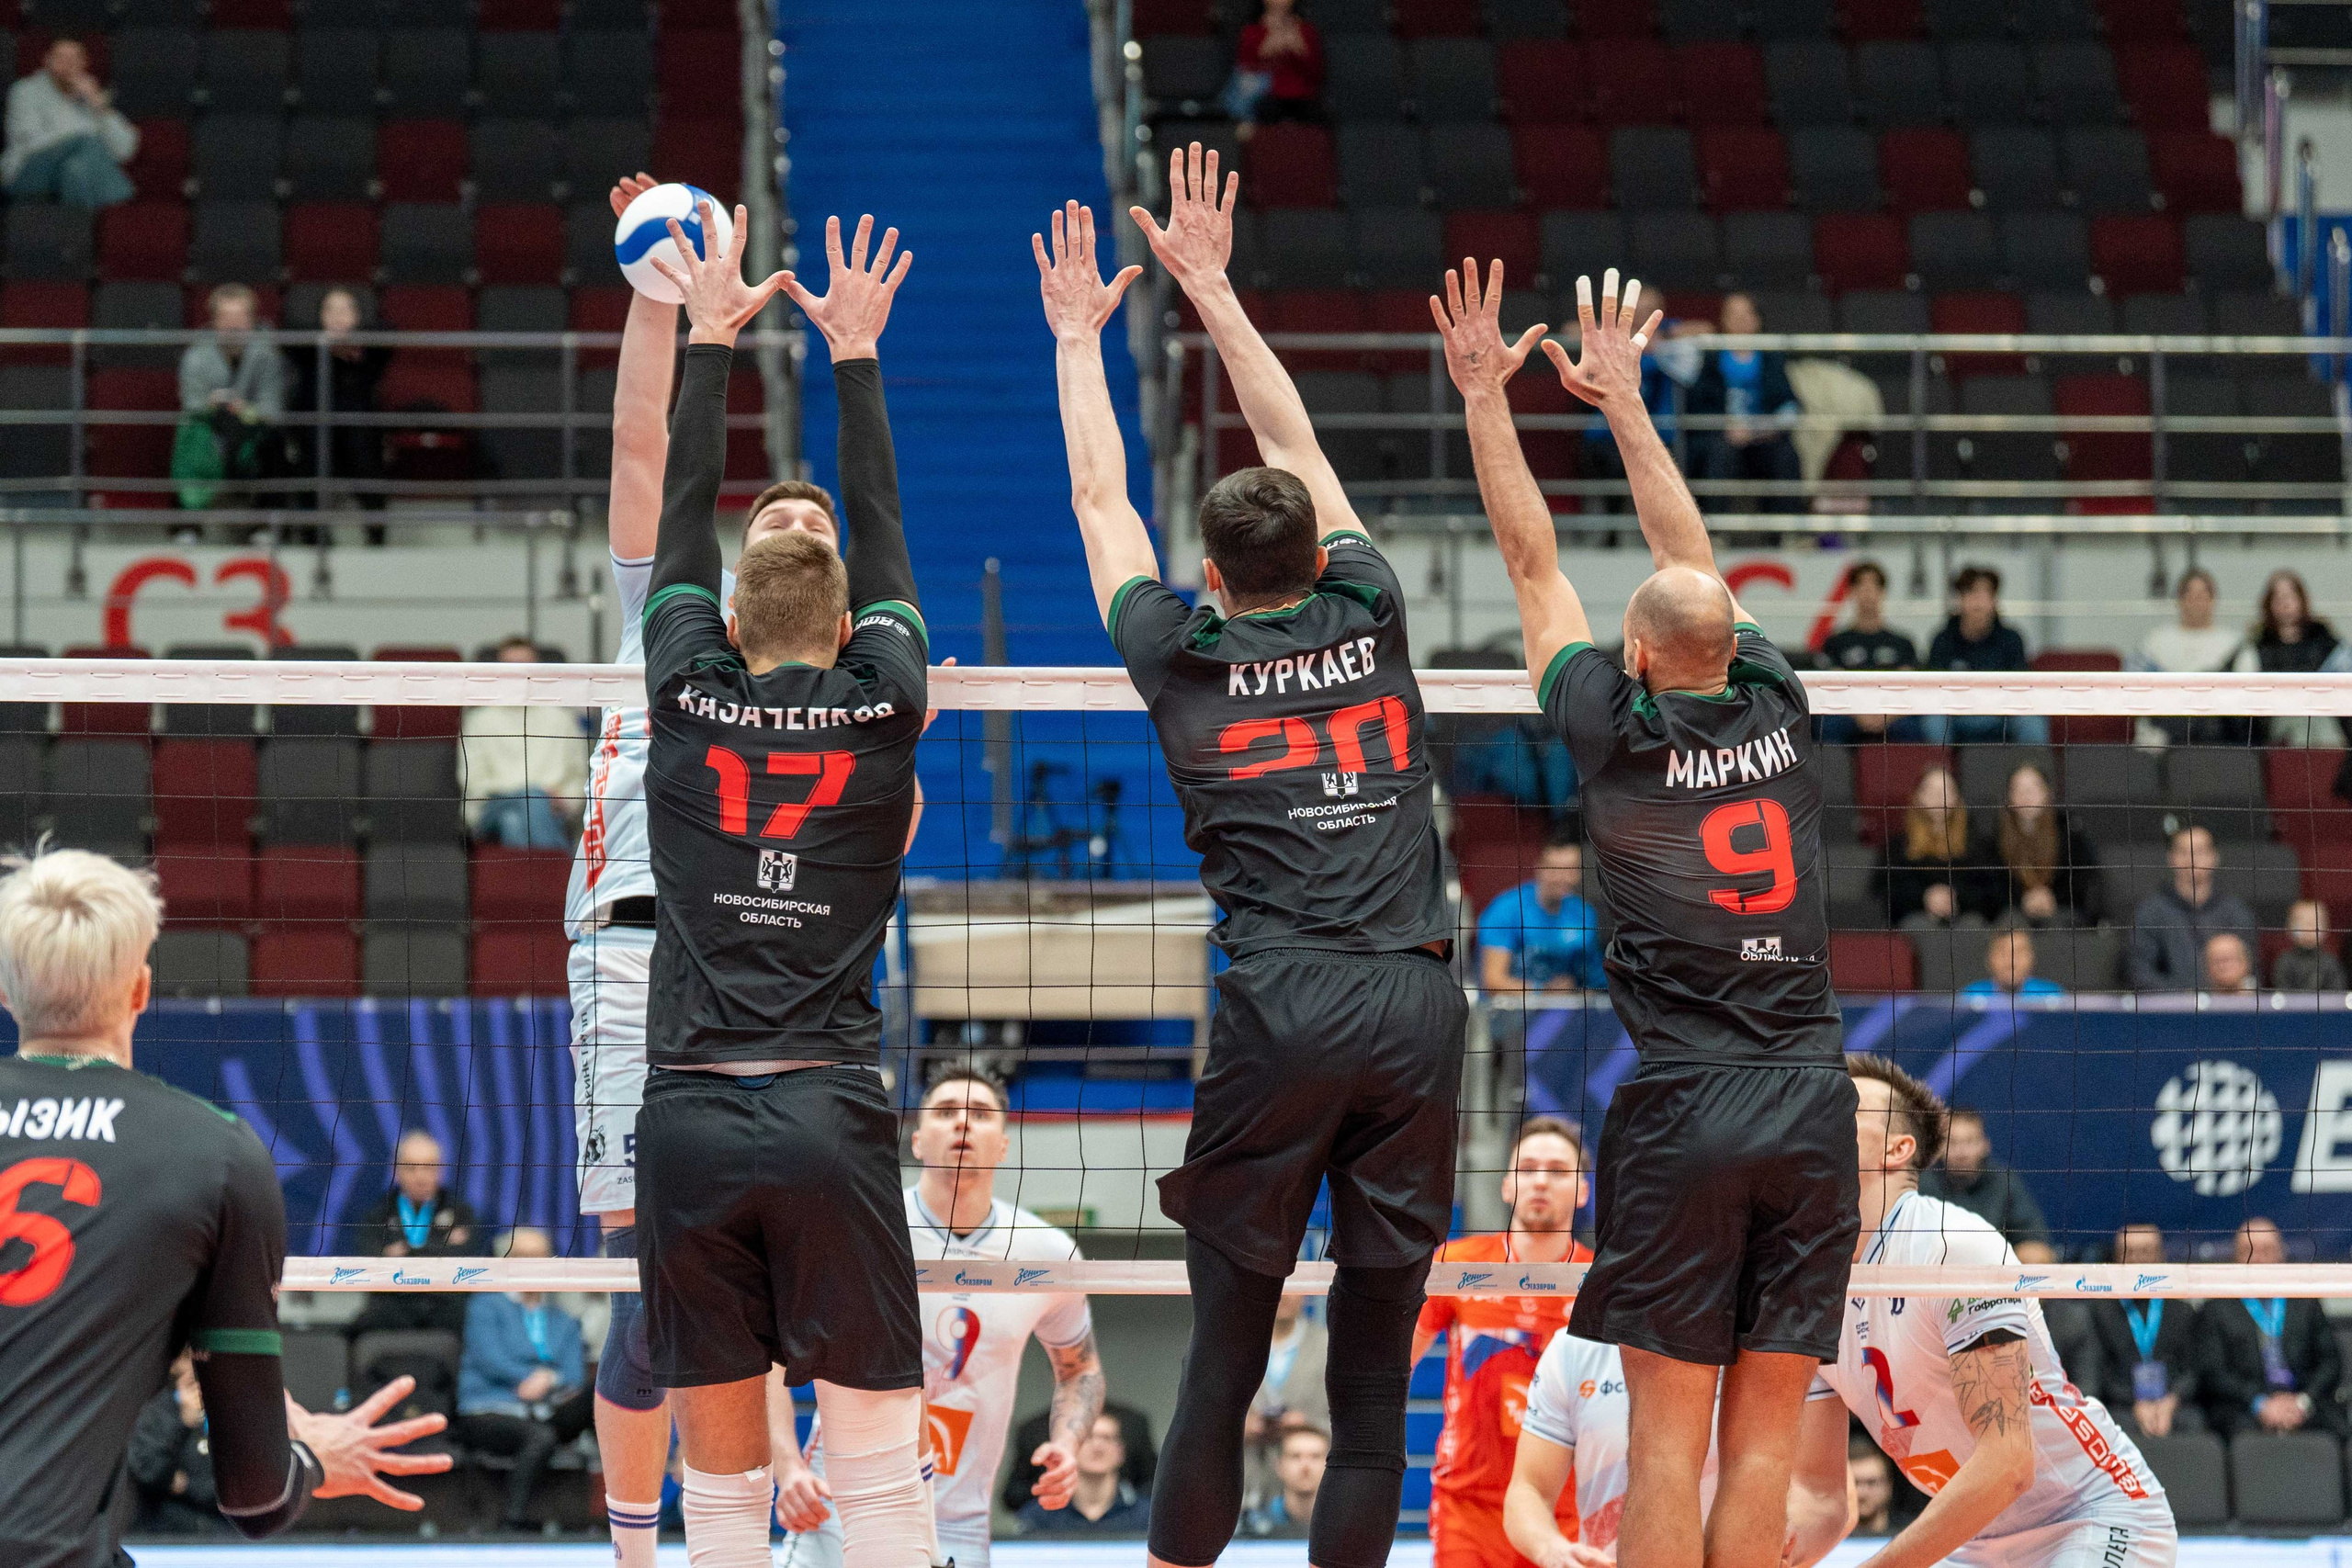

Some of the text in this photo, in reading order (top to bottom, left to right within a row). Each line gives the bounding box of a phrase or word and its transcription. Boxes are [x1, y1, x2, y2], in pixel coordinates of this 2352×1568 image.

[1228, 637, 1376, 696] КУРКАЕВ
[1217, 695, 1410, 781] 20
[1666, 727, 1798, 789] МАРКИН
[705, 743, 856, 840] 17
[1317, 814, 1376, 830] ОБЛАСТЬ
[1698, 797, 1798, 916] 9
[713, 893, 831, 916] НОВОСИБИРСКАЯ
[740, 911, 802, 929] ОБЛАСТЬ
[0, 1156, 102, 1307] 6
[936, 1306, 980, 1381] 9
[1861, 1346, 1921, 1429] 2
[2102, 1527, 2129, 1568] ЛЕГА
